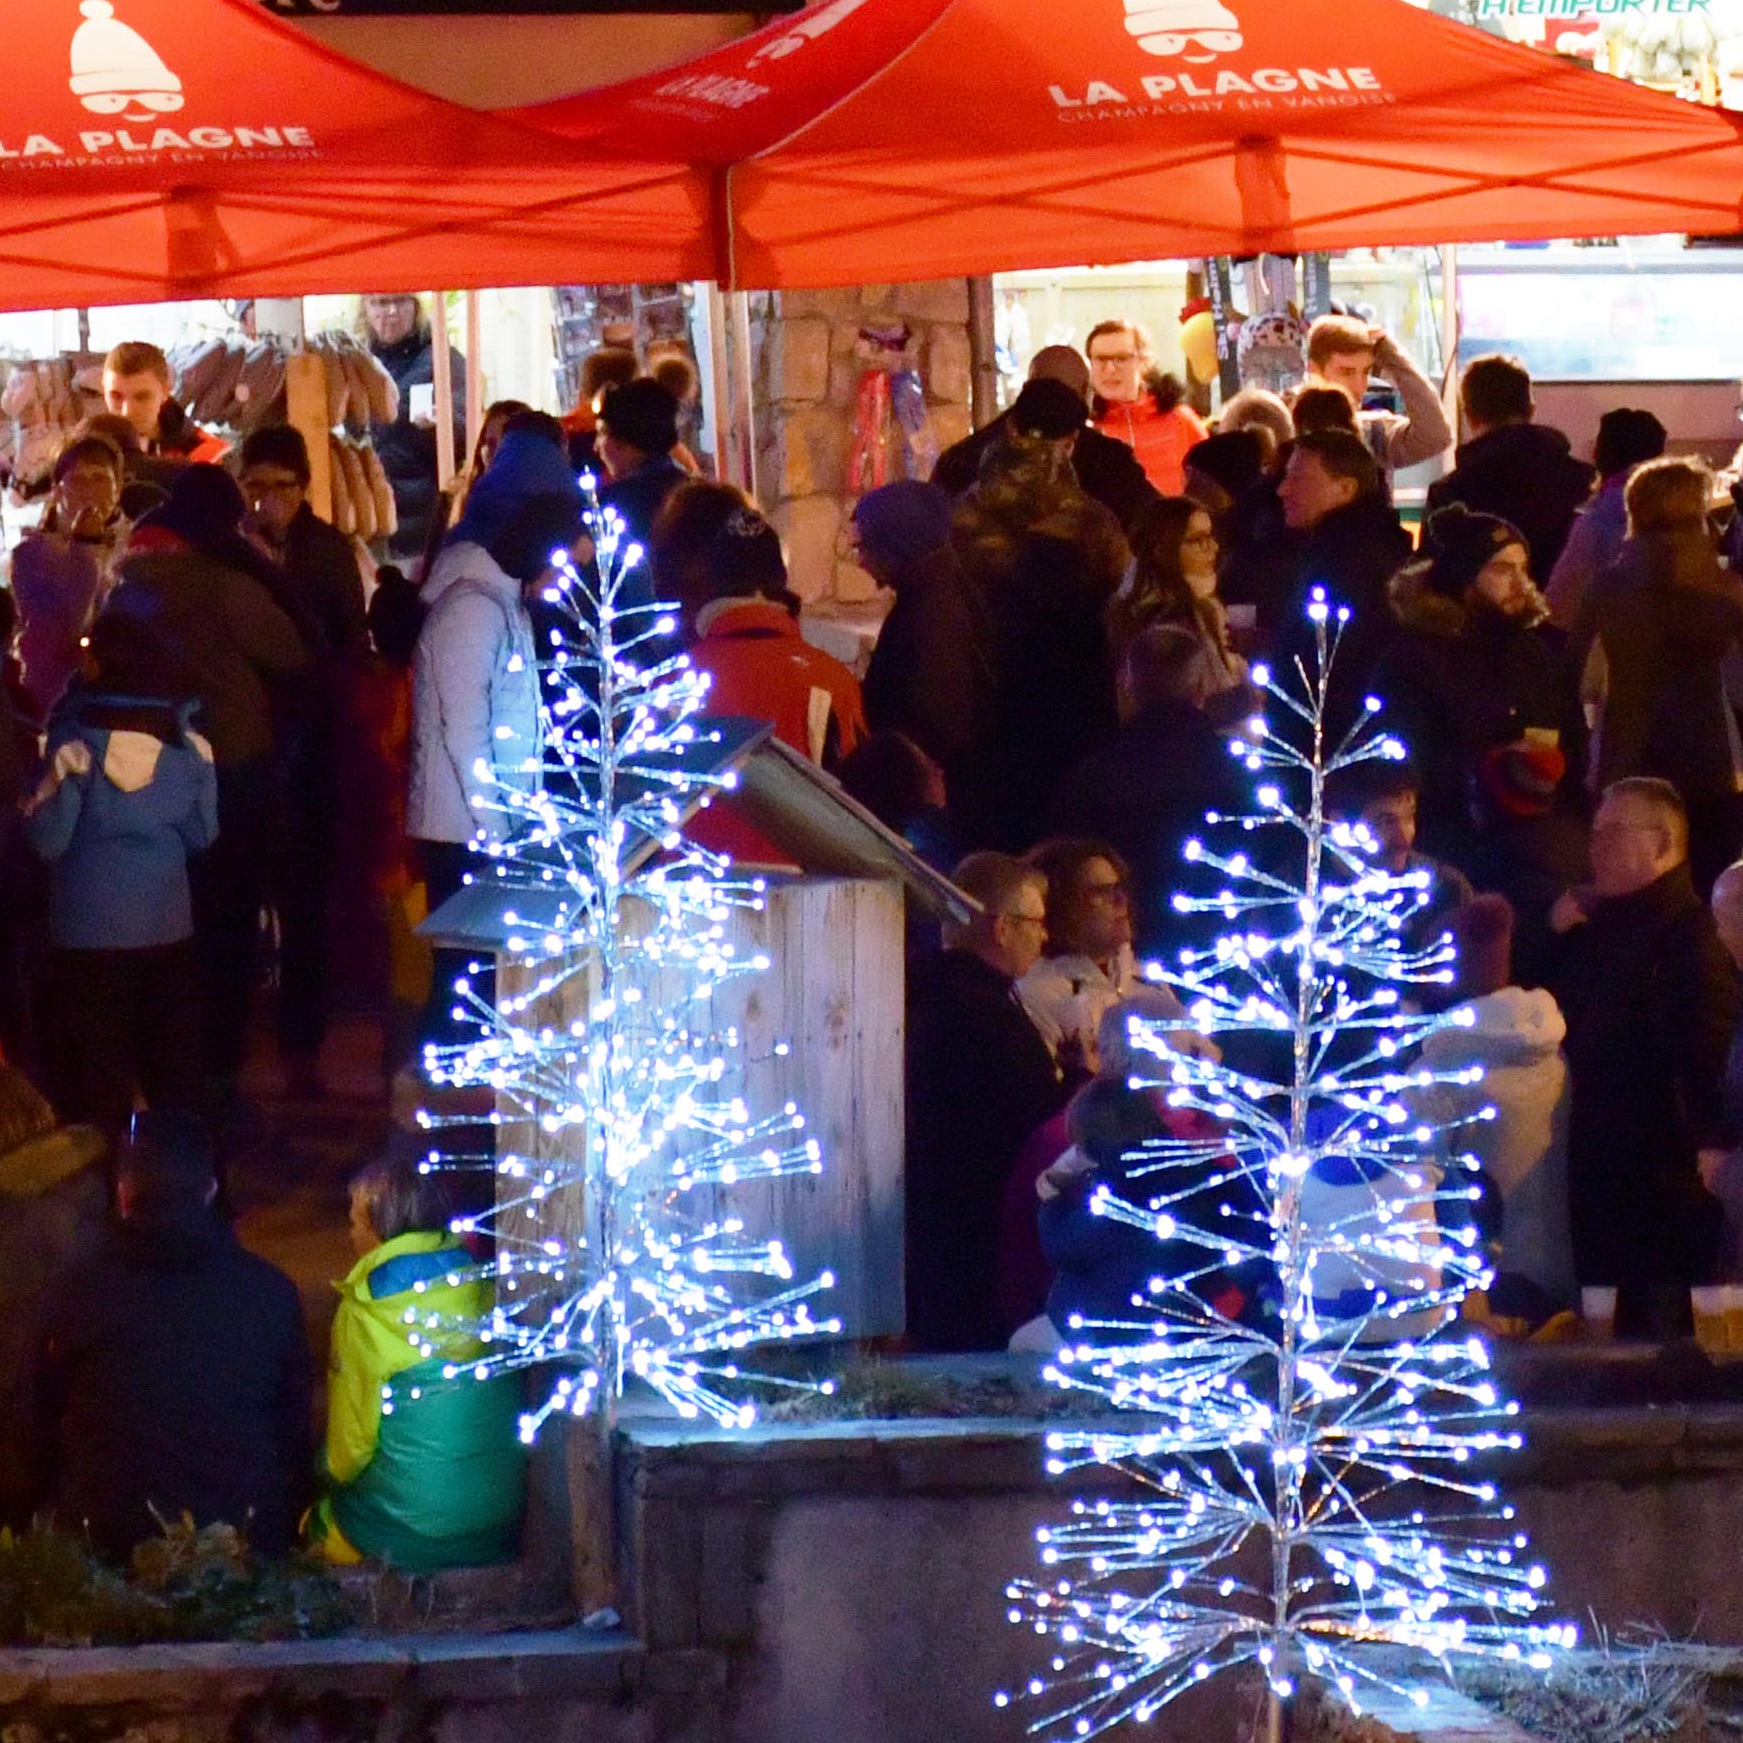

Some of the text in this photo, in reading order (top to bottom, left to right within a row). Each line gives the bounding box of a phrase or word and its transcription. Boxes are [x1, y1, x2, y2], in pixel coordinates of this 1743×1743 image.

[1048, 67, 1381, 108] LA PLAGNE
[79, 126, 315, 153] PLAGNE
